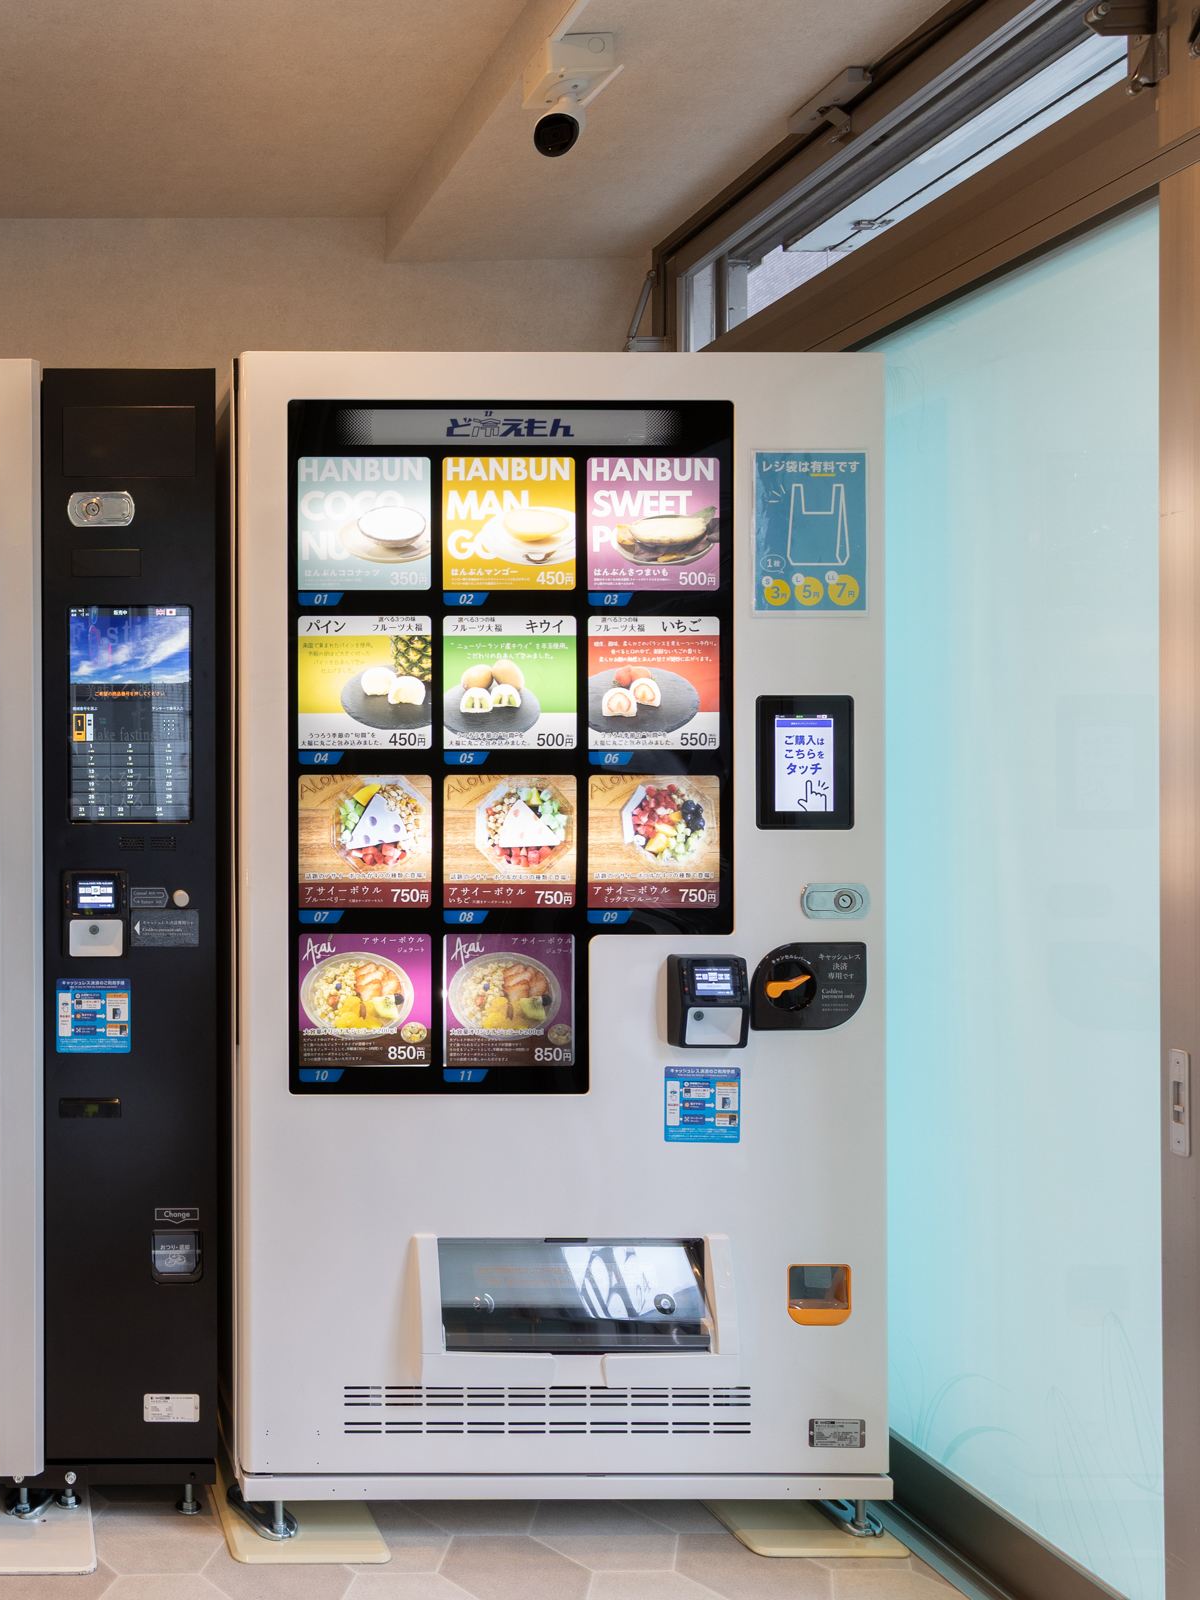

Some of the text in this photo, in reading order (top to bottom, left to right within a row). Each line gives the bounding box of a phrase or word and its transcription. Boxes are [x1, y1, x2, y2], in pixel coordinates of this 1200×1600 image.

[446, 417, 575, 437] ど冷えもん
[300, 458, 423, 482] HANBUN
[446, 457, 570, 481] HANBUN
[591, 458, 714, 482] HANBUN
[762, 461, 860, 473] レジ袋は有料です
[766, 558, 781, 568] 1枚
[304, 569, 380, 577] はんぶんココナッツ
[451, 567, 518, 576] はんぶんマンゴー
[593, 568, 669, 577] はんぶんさつまいも
[390, 572, 428, 586] 350円
[536, 571, 574, 585] 450円
[678, 571, 716, 586] 500円
[314, 594, 328, 604] 01
[459, 594, 473, 604] 02
[604, 594, 618, 605] 03
[306, 619, 346, 634] パイン
[372, 623, 423, 632] フルーツ大福
[451, 624, 503, 632] フルーツ大福
[525, 619, 564, 633] キウイ
[595, 624, 646, 632] フルーツ大福
[661, 618, 702, 633] いちご
[388, 732, 426, 747] 450円
[536, 733, 574, 747] 500円
[680, 732, 717, 747] 550円
[784, 734, 825, 745] ご購入は
[314, 753, 329, 763] 04
[459, 753, 474, 764] 05
[604, 753, 619, 764] 06
[784, 748, 825, 759] こちらを
[786, 762, 822, 775] タッチ
[304, 886, 382, 895] アサイーボウル
[390, 888, 429, 903] 750円
[448, 887, 526, 896] アサイーボウル
[592, 886, 670, 895] アサイーボウル
[678, 888, 717, 903] 750円
[534, 890, 572, 905] 750円
[313, 911, 329, 922] 07
[458, 911, 474, 922] 08
[602, 912, 618, 922] 09
[362, 936, 425, 944] アサイーボウル
[511, 937, 573, 945] アサイーボウル
[832, 962, 848, 971] 決済
[828, 972, 854, 980] 専用です
[387, 1045, 426, 1060] 850円
[534, 1047, 572, 1062] 850円
[315, 1070, 329, 1081] 10
[459, 1070, 473, 1081] 11
[163, 1210, 191, 1219] Change
